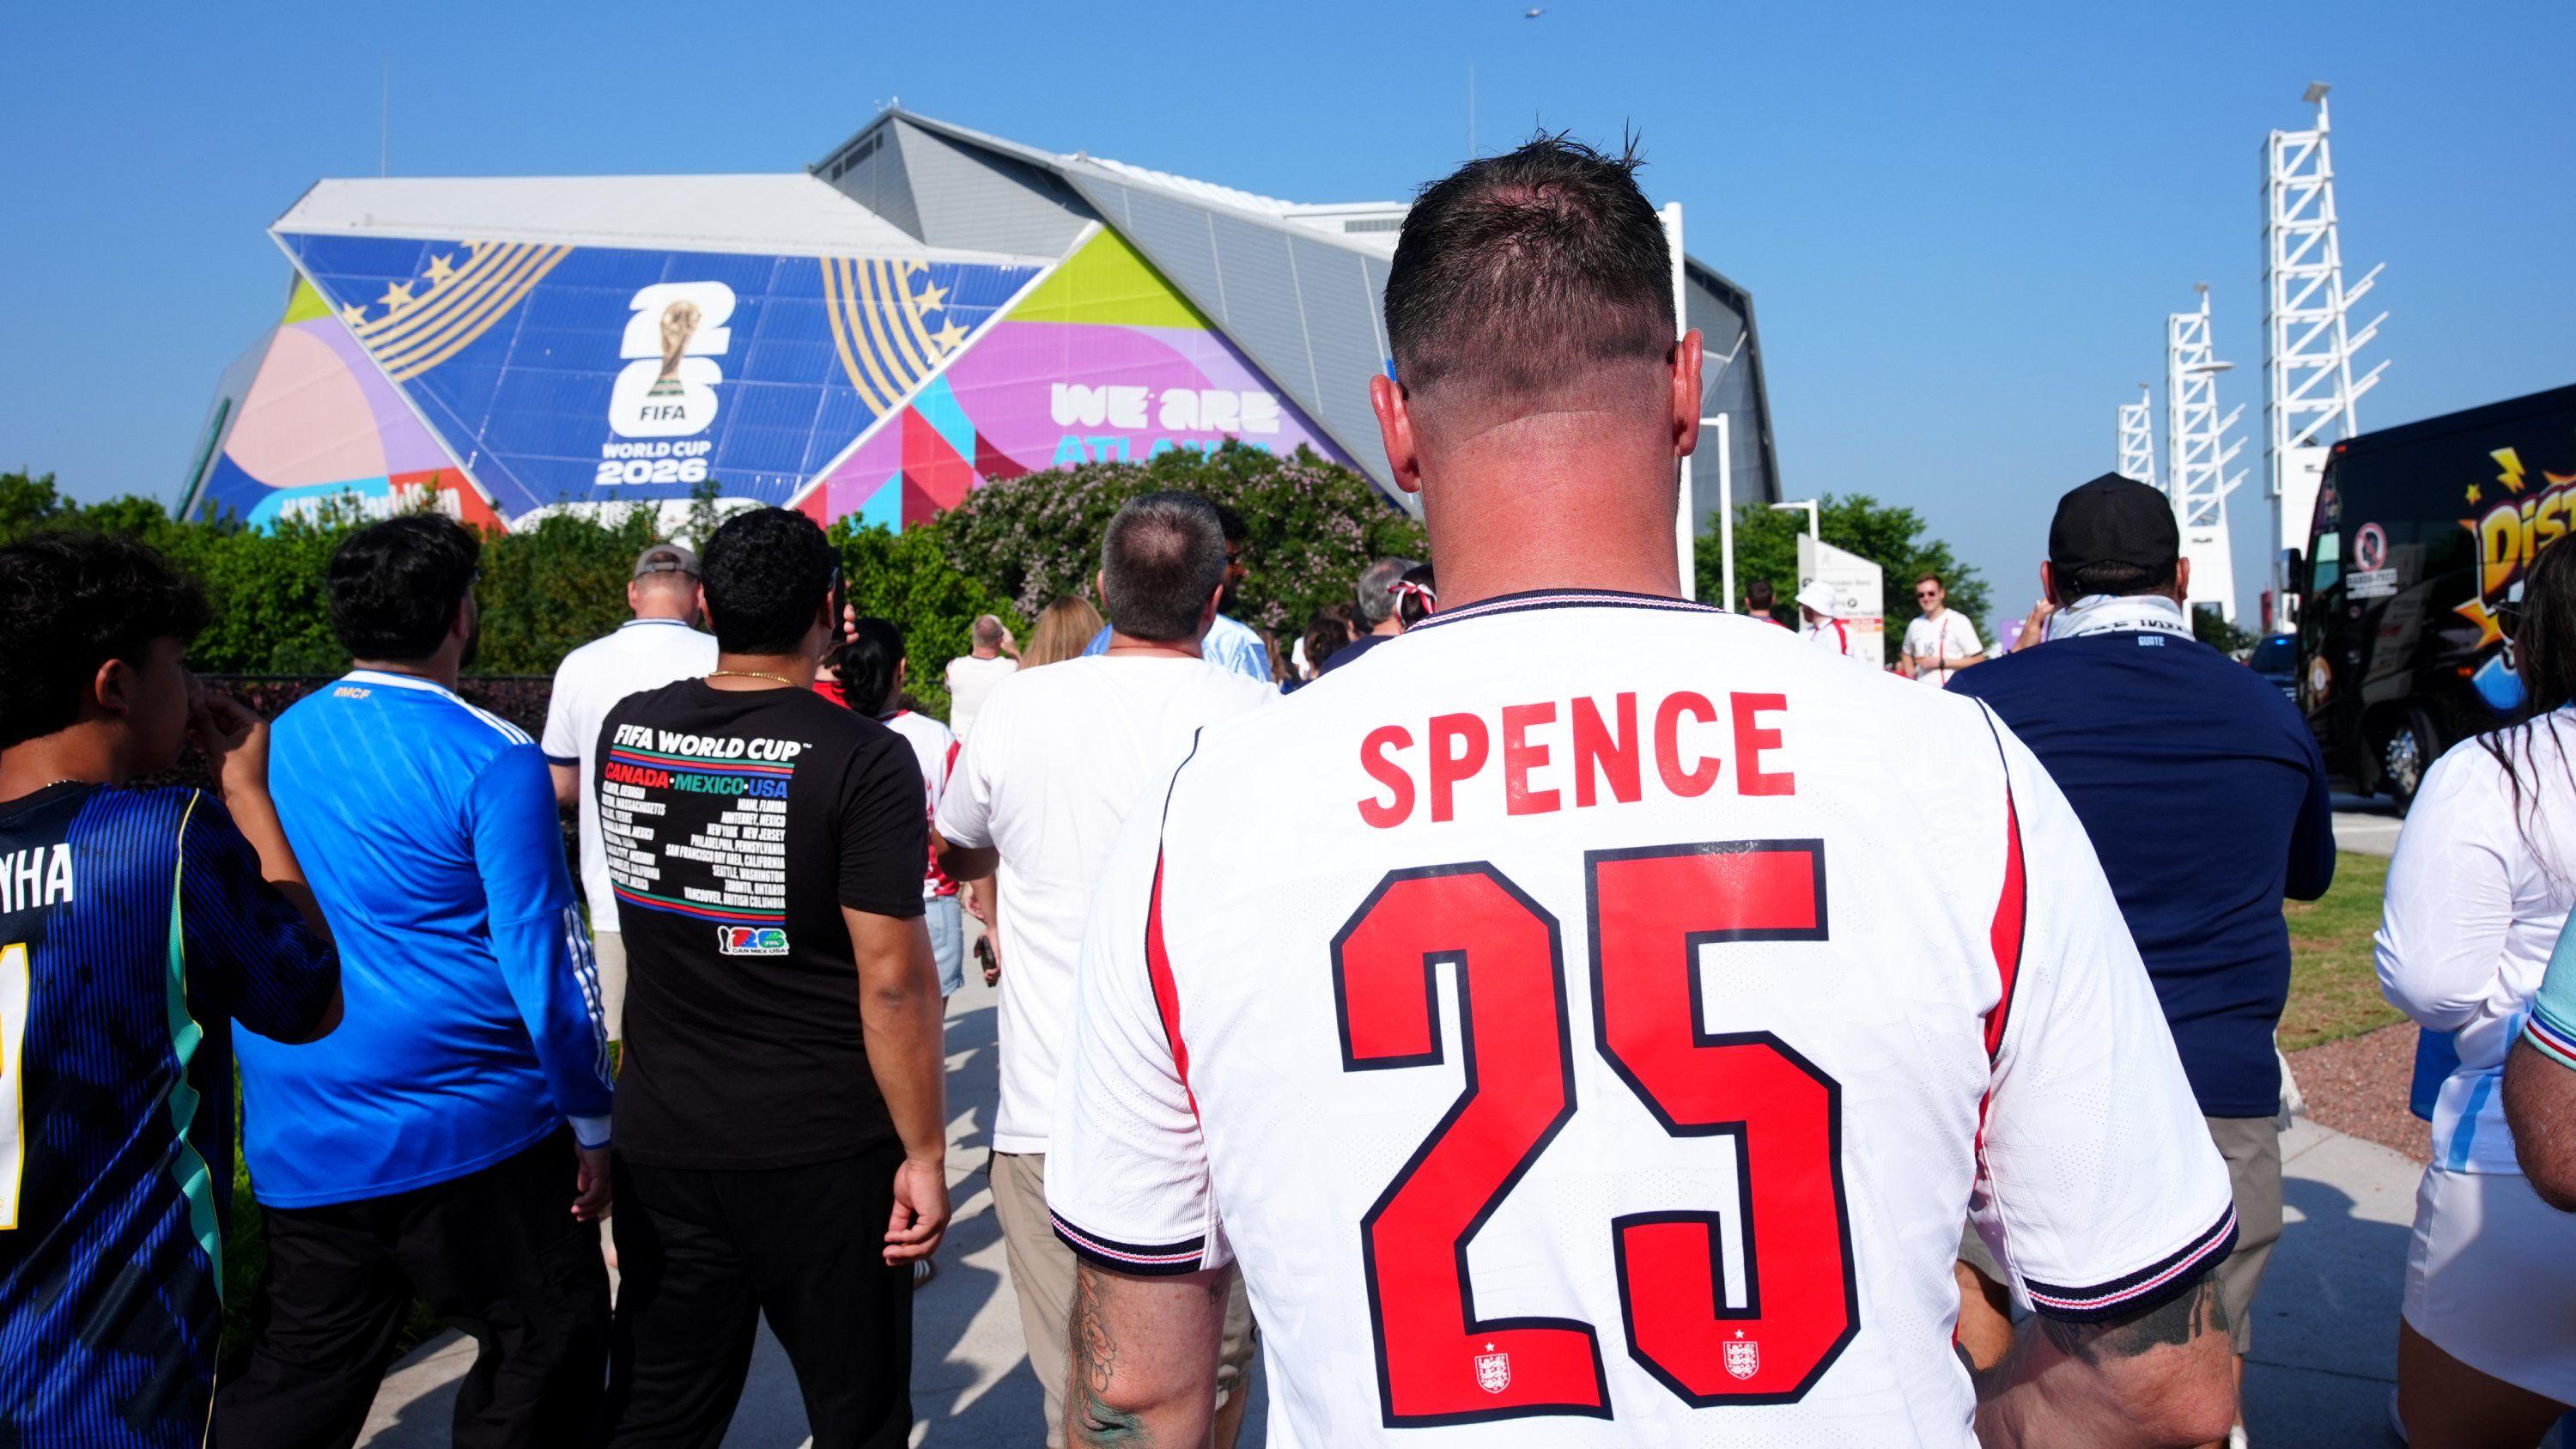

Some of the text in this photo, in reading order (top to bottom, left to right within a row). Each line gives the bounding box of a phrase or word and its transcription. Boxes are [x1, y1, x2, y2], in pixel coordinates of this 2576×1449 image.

[640, 405, 686, 421] FIFA
[1050, 382, 1149, 429] WE
[602, 440, 712, 459] WORLD CUP
[595, 458, 708, 485] 2026
[2138, 636, 2165, 646] GUATE
[333, 686, 371, 699] RMCF
[613, 723, 653, 750] FIFA
[658, 730, 744, 758] WORLD
[1358, 691, 1795, 829] SPENCE
[605, 762, 788, 799] CANADA MEXICO USA
[759, 799, 787, 813] FLORIDA
[759, 813, 786, 827] MEXICO
[758, 827, 786, 842] JERSEY
[734, 839, 785, 855] PENNSYLVANIA
[665, 843, 680, 857] SAN
[744, 854, 786, 869] CALIFORNIA
[738, 868, 785, 883] WASHINGTON
[754, 882, 786, 896] ONTARIO
[749, 895, 786, 909] COLUMBIA
[1329, 837, 1862, 1428] 25
